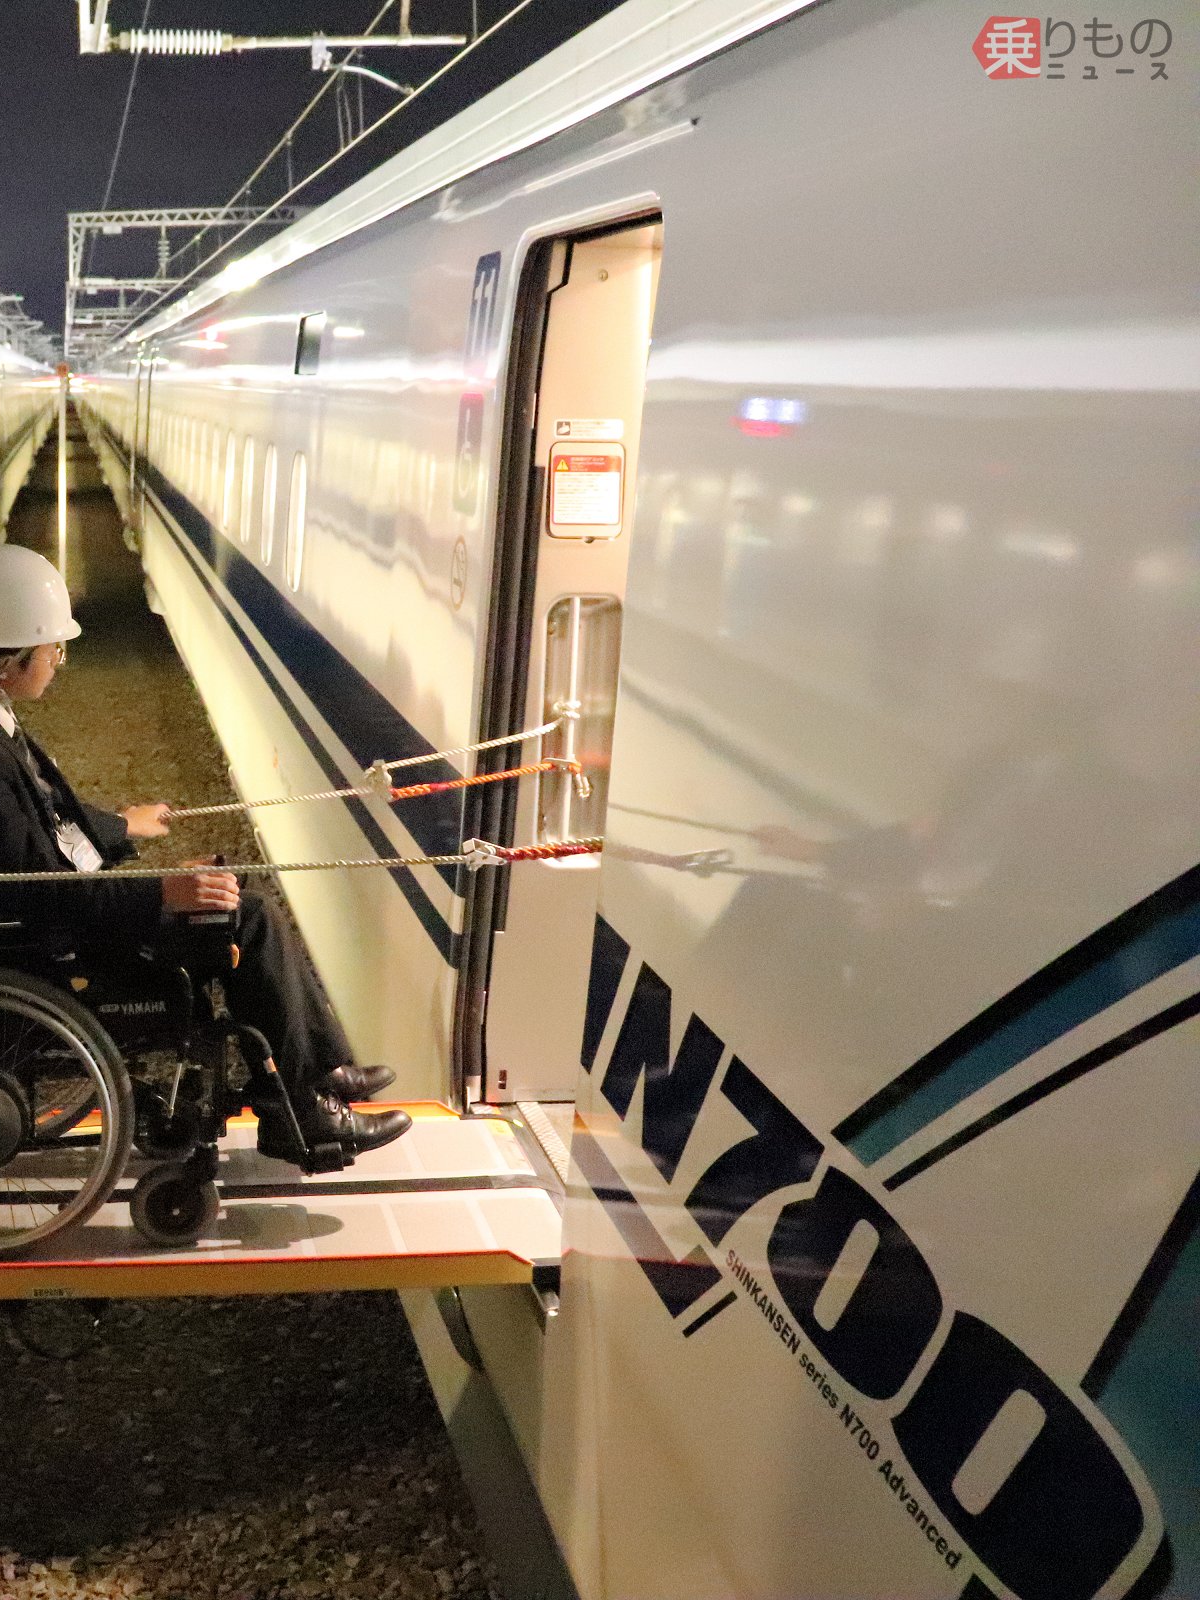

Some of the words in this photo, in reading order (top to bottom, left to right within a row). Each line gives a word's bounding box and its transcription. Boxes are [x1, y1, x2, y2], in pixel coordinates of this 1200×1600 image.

[470, 268, 497, 357] 11
[120, 1000, 166, 1015] YAMAHA
[725, 1249, 801, 1355] SHINKANSEN
[798, 1353, 839, 1408] series
[839, 1403, 880, 1460] N700
[878, 1459, 963, 1570] Advanced
